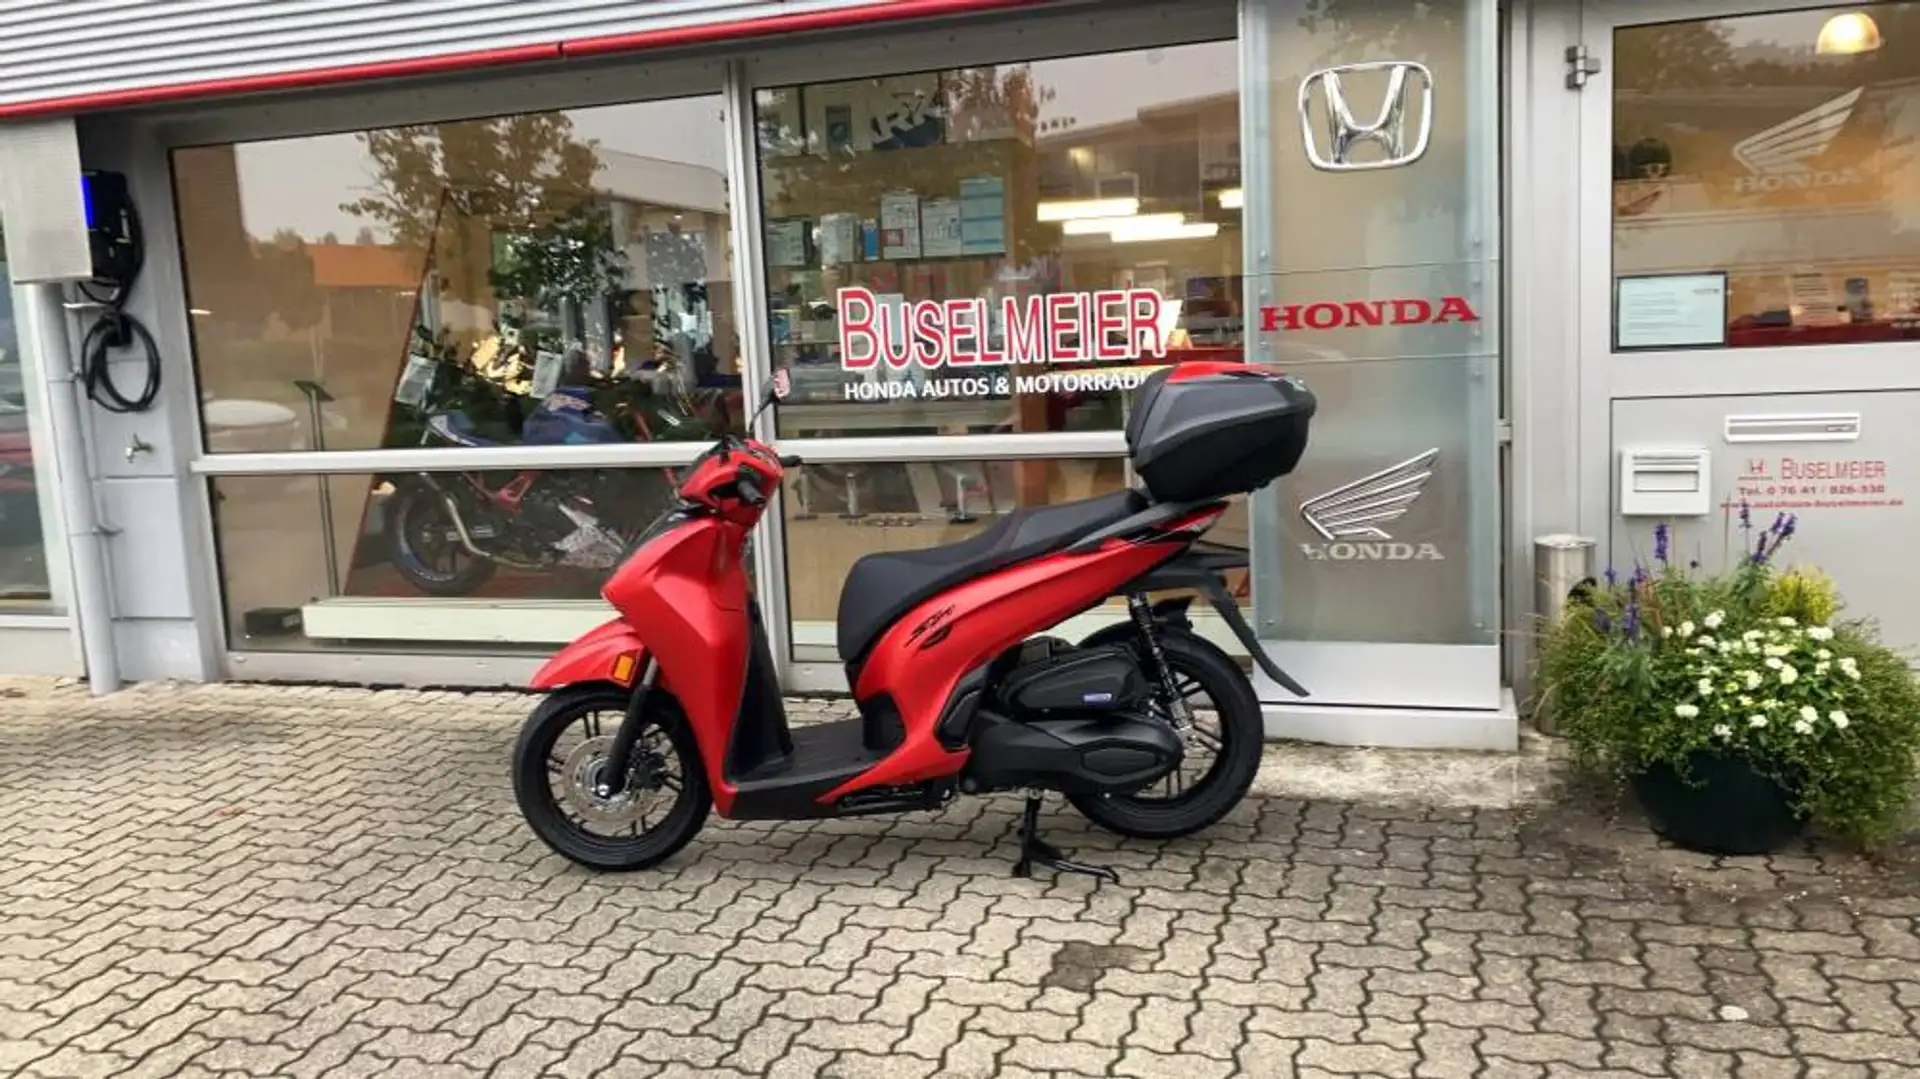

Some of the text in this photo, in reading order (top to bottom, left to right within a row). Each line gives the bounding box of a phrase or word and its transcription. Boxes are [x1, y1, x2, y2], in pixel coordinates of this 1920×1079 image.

[1735, 169, 1861, 194] HONDA
[1260, 296, 1480, 332] HONDA
[837, 287, 1166, 371] BUSELMEIER
[844, 381, 916, 401] HONDA
[921, 378, 990, 398] AUTOS
[995, 377, 1010, 395] &
[1780, 457, 1886, 479] BUSELMEIER
[1301, 541, 1445, 561] HONDA
